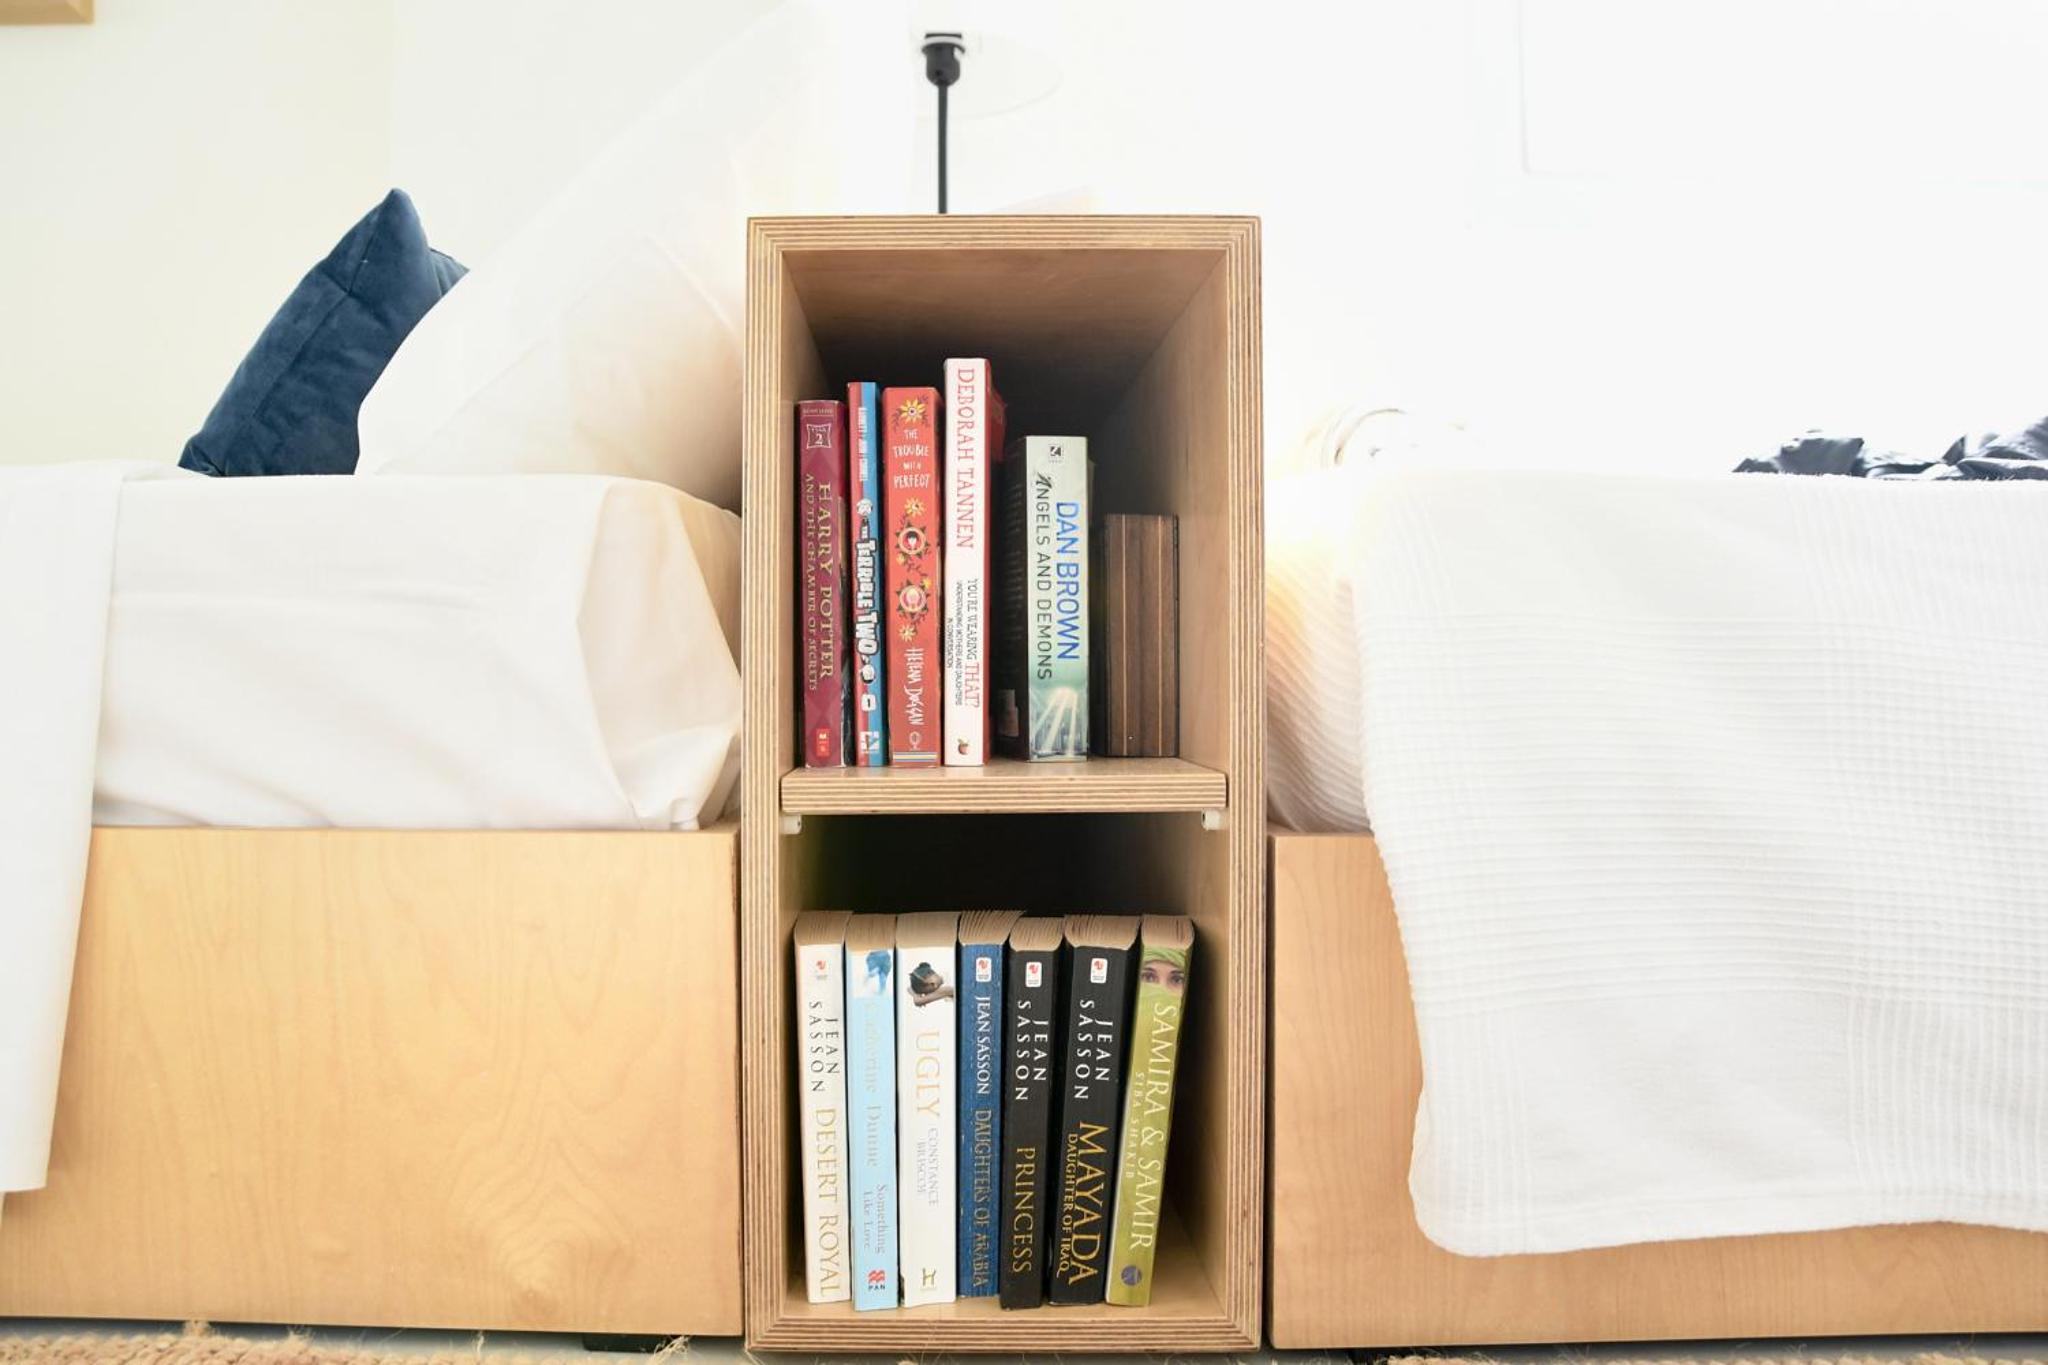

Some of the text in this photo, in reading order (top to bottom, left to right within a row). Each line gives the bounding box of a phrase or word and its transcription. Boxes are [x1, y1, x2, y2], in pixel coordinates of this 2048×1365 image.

[814, 433, 823, 446] 2
[892, 444, 930, 458] TROUBLE
[904, 428, 919, 441] THE
[957, 367, 975, 549] DEBORAH TANNEN
[893, 473, 931, 489] PERFECT
[806, 474, 818, 691] AND THE CHAMBER OF SECRETS
[818, 483, 834, 679] HARRY POTTER
[1035, 471, 1053, 680] ANGELS AND DEMONS
[1056, 502, 1080, 660] DAN BROWN
[856, 610, 879, 656] TWO
[905, 647, 925, 685] HELENA
[967, 615, 979, 660] WEARING
[965, 661, 980, 708] THAT?
[809, 1000, 827, 1092] SASSON
[825, 1017, 840, 1074] JEAN
[974, 995, 991, 1033] JEAN
[916, 1029, 940, 1117] UGLY
[977, 1036, 991, 1095] SASSON
[1015, 999, 1031, 1100] SASSON
[1033, 1020, 1049, 1081] JEAN
[1074, 999, 1095, 1100] SASSON
[1094, 1019, 1113, 1081] JEAN
[866, 1104, 882, 1168] Dunne
[974, 1109, 992, 1203] DAUGHTERS
[1125, 1072, 1145, 1179] SIBA SHAKIB
[1129, 1003, 1178, 1251] SAMIRA & SAMIR
[917, 1140, 927, 1196] BRISCOE
[928, 1127, 940, 1206] CONSTANCE
[816, 1108, 840, 1298] DESERT ROYAL
[863, 1191, 874, 1249] Like Love
[872, 1183, 889, 1254] Something
[974, 1207, 990, 1227] OF
[1013, 1146, 1036, 1273] PRINCESS
[1057, 1133, 1079, 1278] DAUGHTER OF IRAQ
[1068, 1121, 1110, 1285] MAYADA
[973, 1232, 990, 1287] ARABIA
